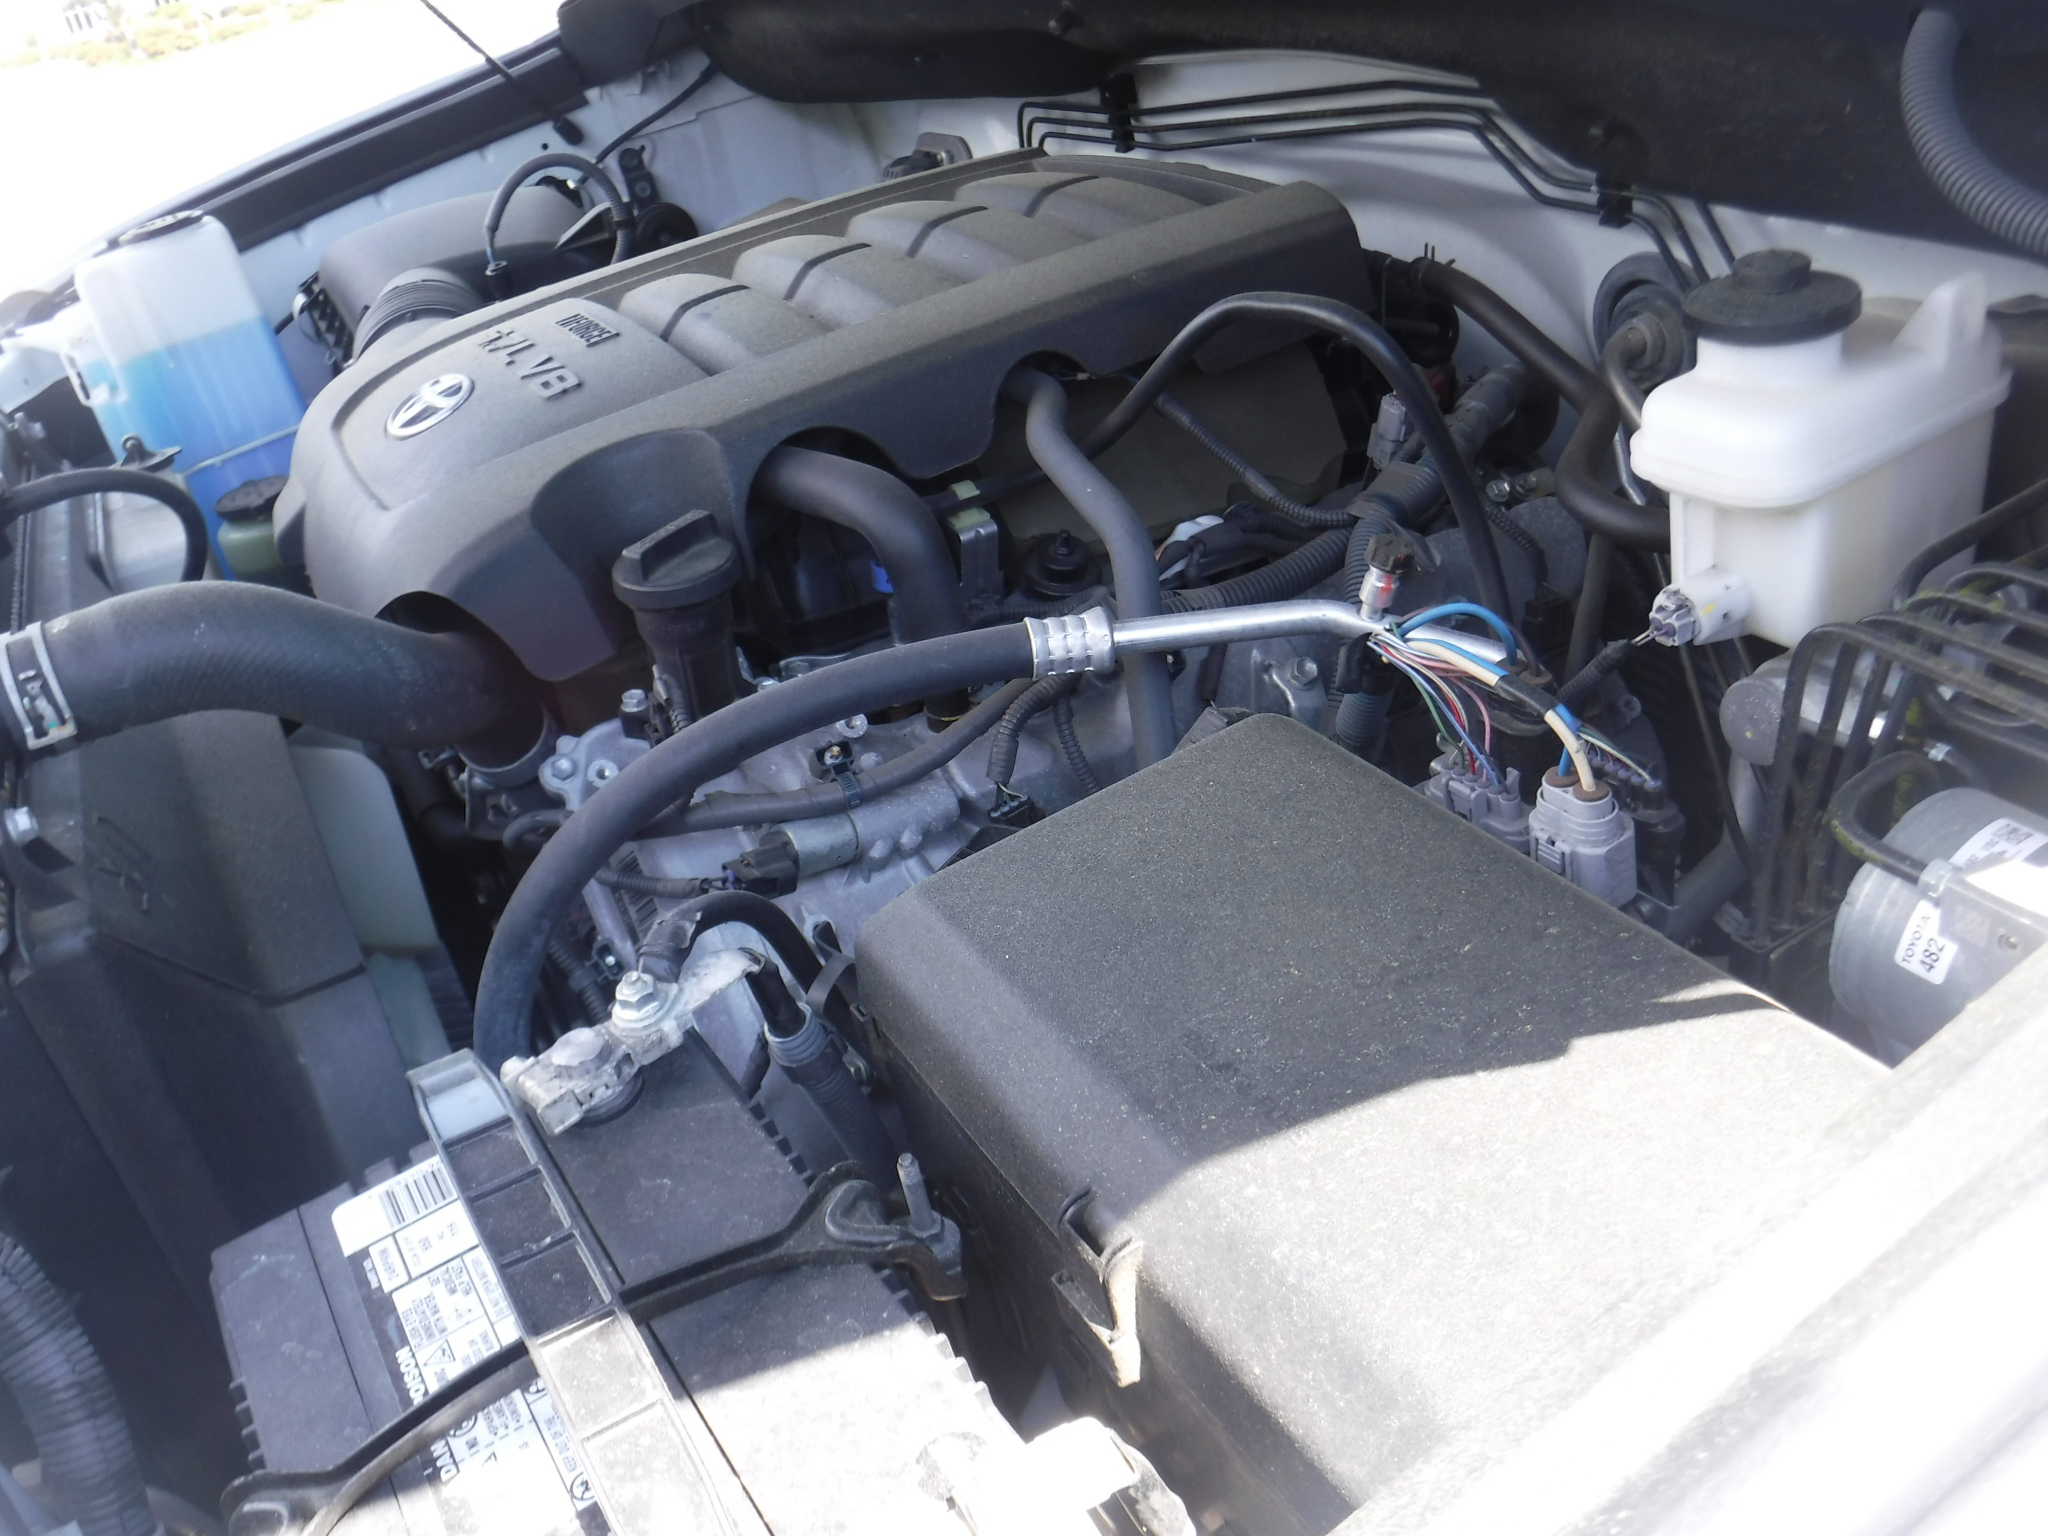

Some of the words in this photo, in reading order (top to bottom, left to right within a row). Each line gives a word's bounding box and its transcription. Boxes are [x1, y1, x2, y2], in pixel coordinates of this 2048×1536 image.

[517, 357, 581, 399] V8
[1901, 917, 1930, 962] TOYOTA
[1920, 939, 1943, 972] 482
